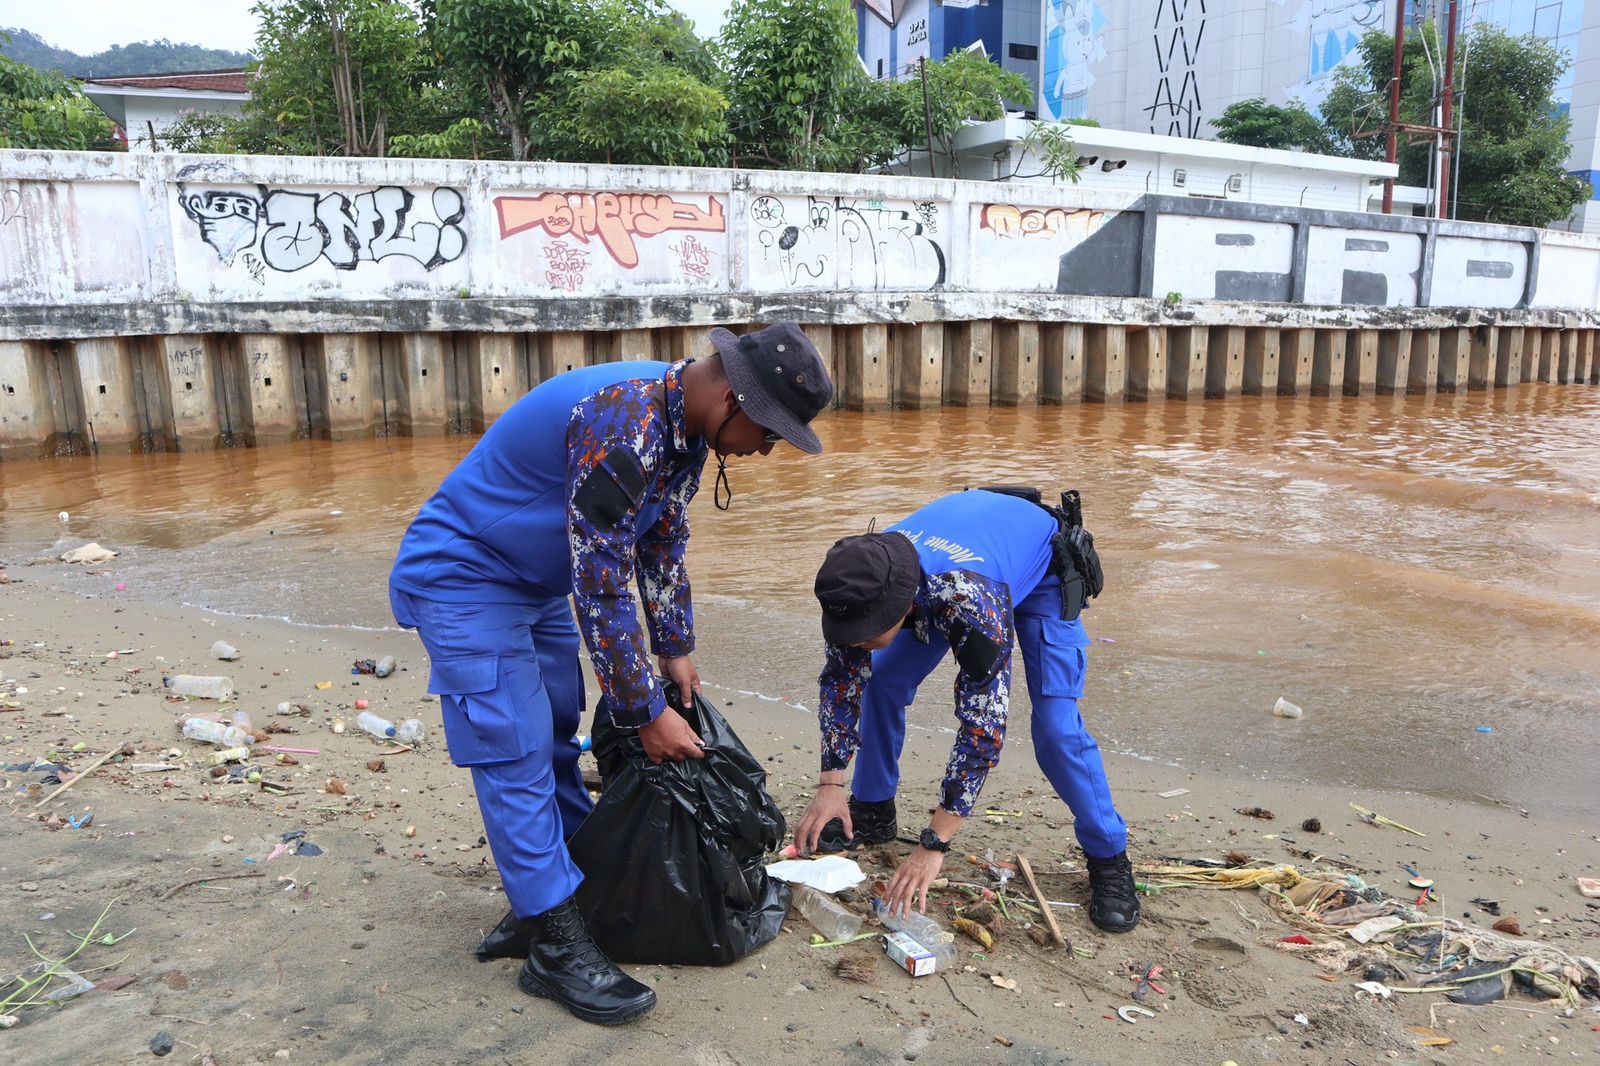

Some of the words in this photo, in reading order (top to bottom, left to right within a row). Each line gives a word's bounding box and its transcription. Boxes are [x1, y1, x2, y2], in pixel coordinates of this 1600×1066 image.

[908, 18, 925, 33] DPR
[907, 31, 927, 46] PAPUA
[923, 535, 985, 564] Marine
